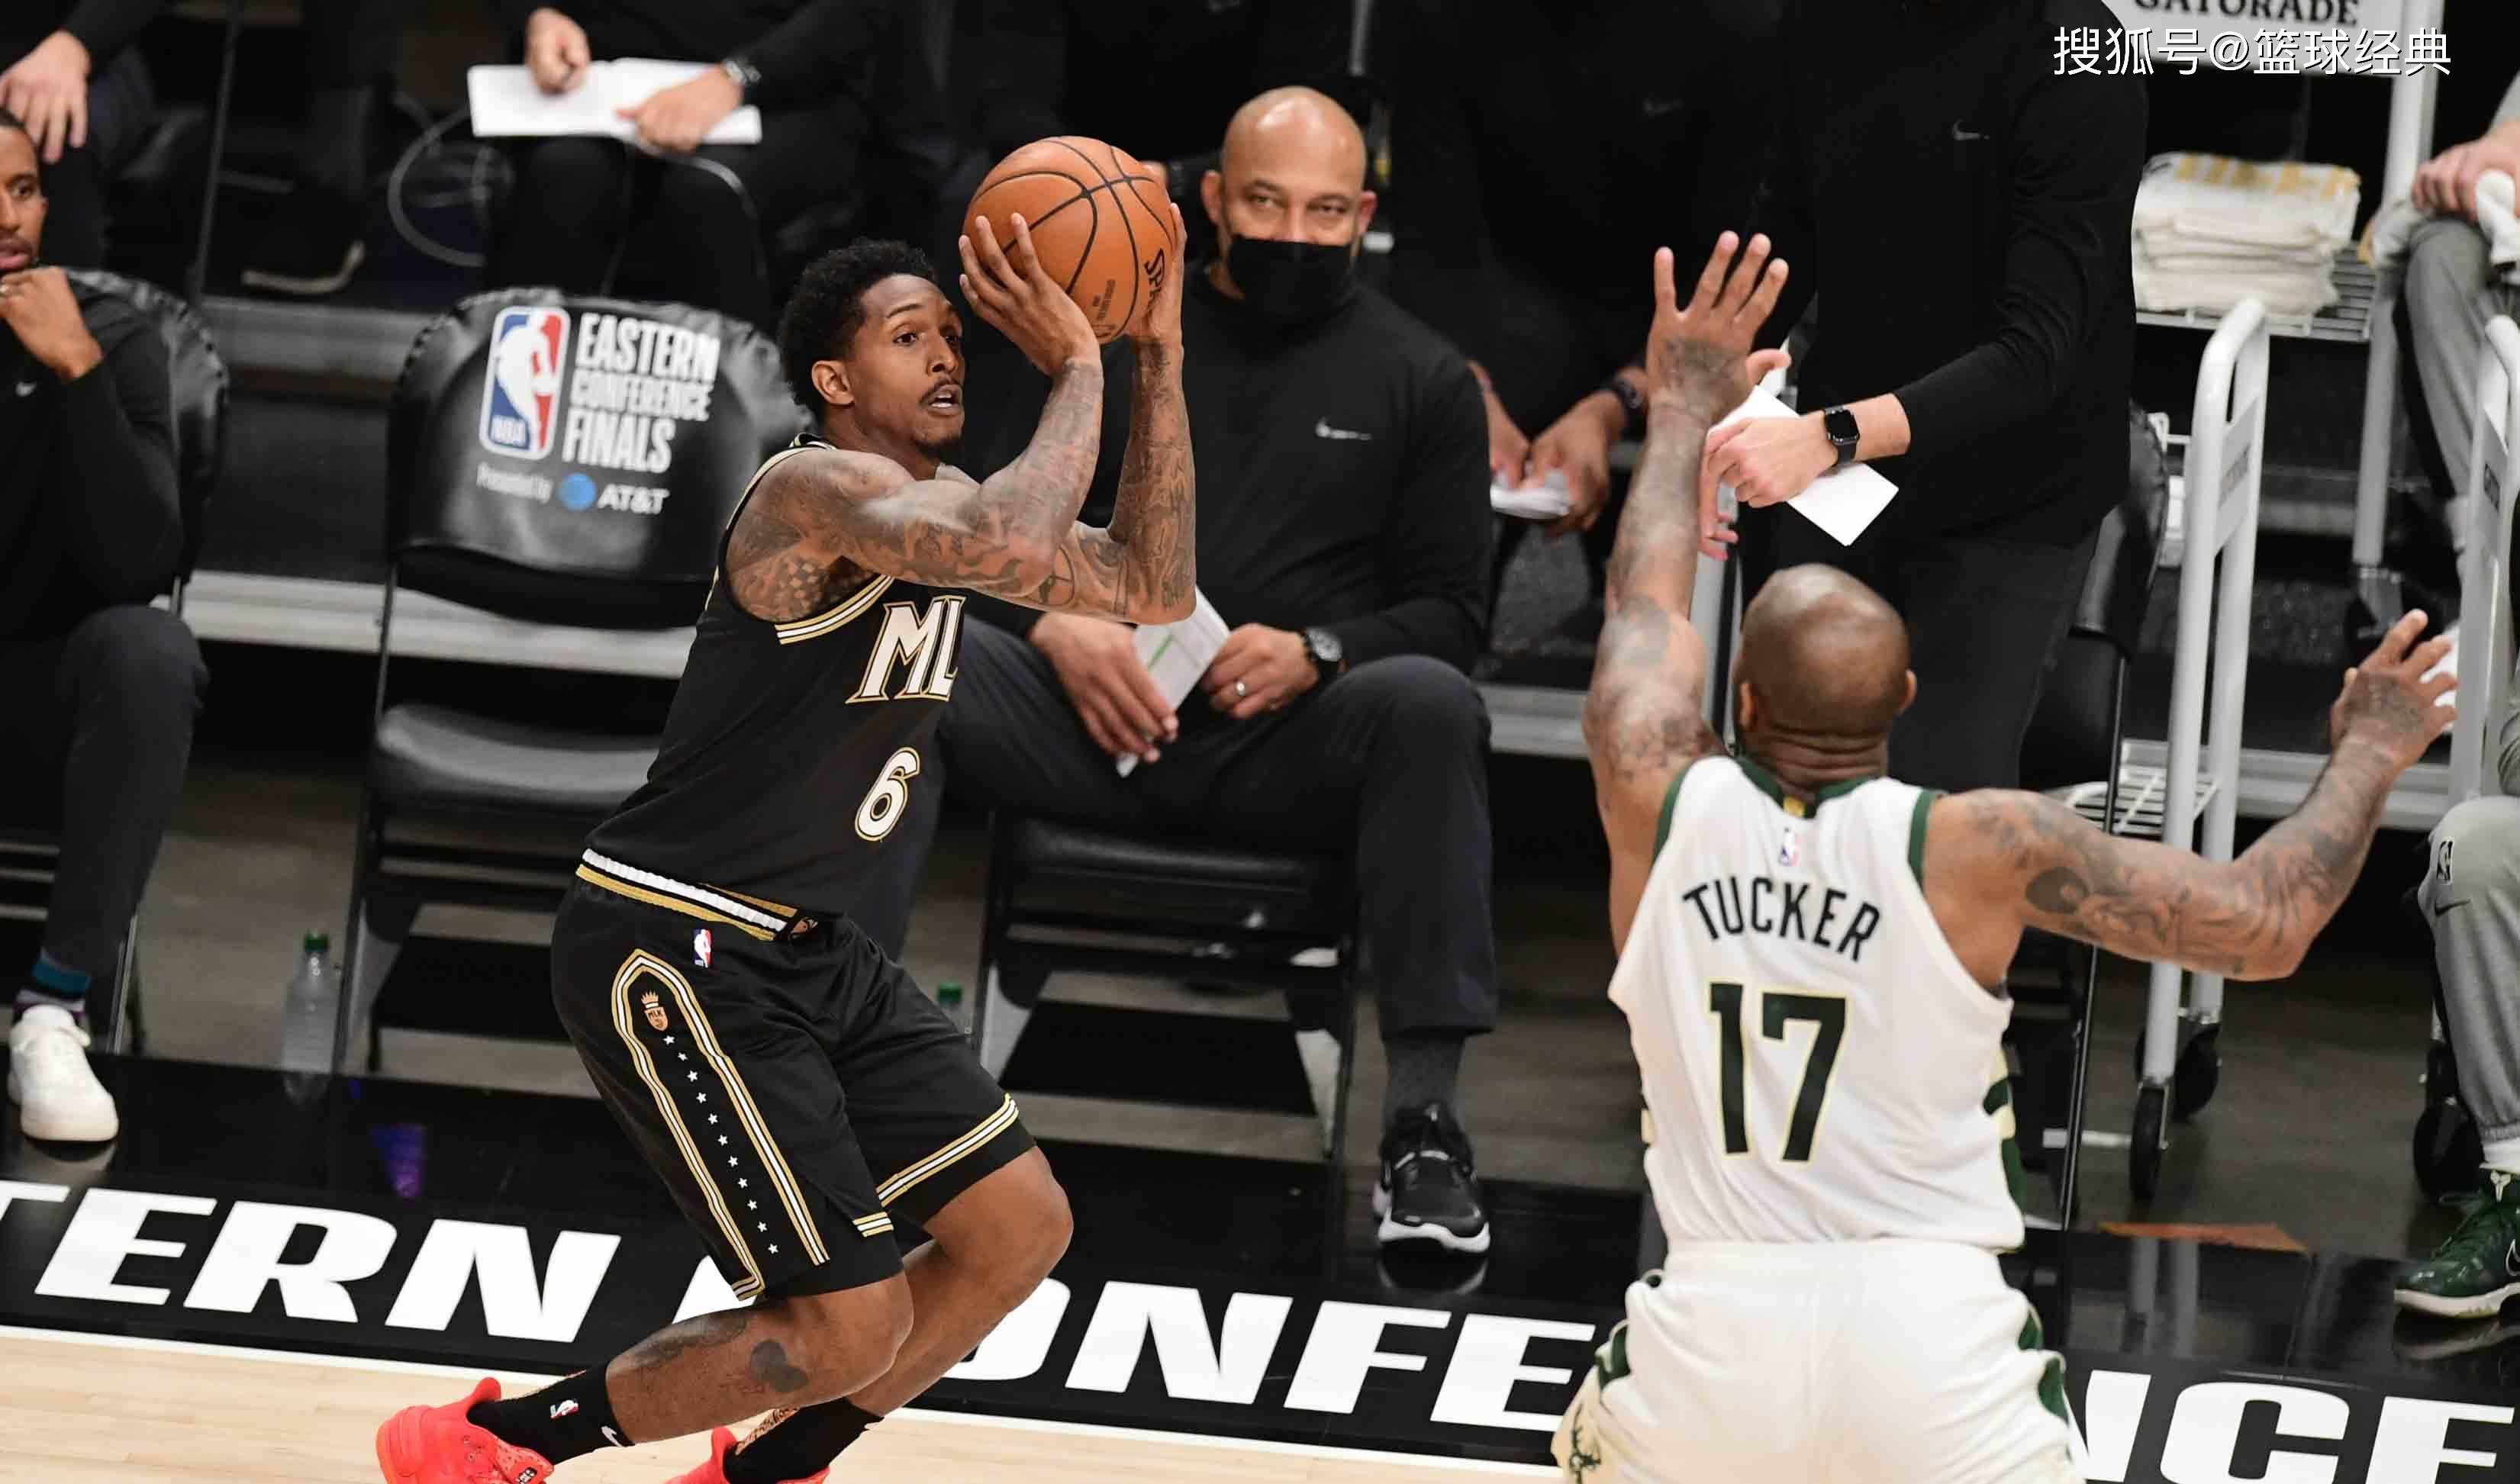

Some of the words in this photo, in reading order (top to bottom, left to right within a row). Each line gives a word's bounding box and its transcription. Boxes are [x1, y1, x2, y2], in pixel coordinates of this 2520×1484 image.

[575, 312, 721, 383] EASTERN
[570, 368, 714, 422] CONFERENCE
[562, 408, 676, 474] FINALS
[597, 484, 670, 514] AT&T
[854, 746, 920, 842] 6
[1682, 876, 1880, 963] TUCKER
[1706, 979, 1848, 1164] 17
